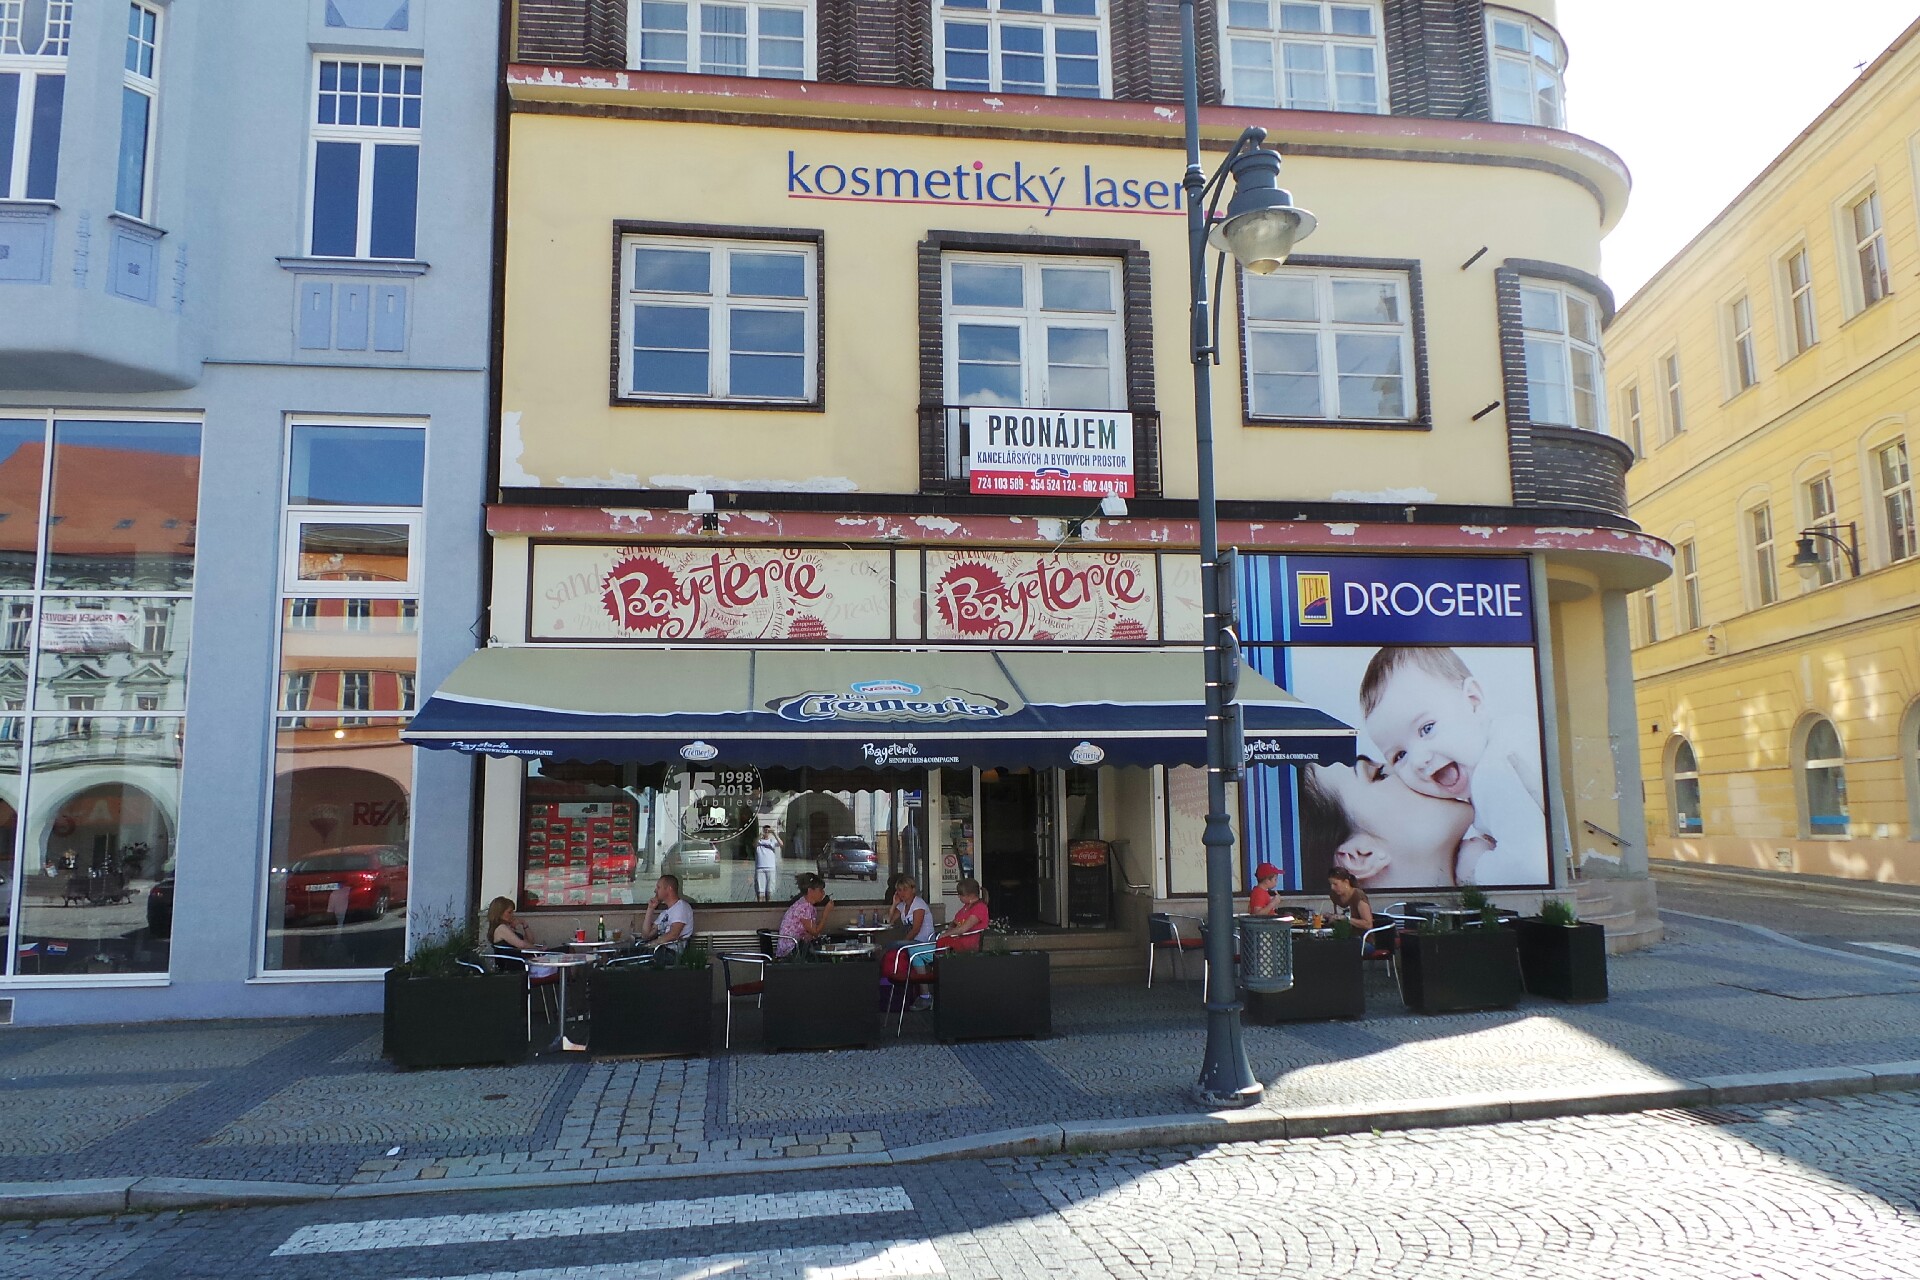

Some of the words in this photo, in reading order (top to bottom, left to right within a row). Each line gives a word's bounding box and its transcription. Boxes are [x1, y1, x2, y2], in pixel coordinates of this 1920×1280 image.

[788, 149, 1066, 217] kosmetický
[988, 412, 1117, 450] PRONÁJEM
[977, 451, 1041, 465] KANCELÁŘSKÝCH
[1043, 454, 1049, 465] A
[1051, 453, 1090, 467] BYTOVÝCH
[1092, 455, 1127, 468] PROSTOR
[977, 477, 991, 489] 724
[994, 477, 1008, 489] 103
[1031, 478, 1045, 491] 354
[1046, 479, 1060, 491] 524
[1063, 479, 1076, 491] 124
[1114, 480, 1128, 493] 761
[1301, 577, 1328, 607] TETA
[1343, 582, 1523, 617] DROGERIE
[777, 693, 1004, 723] Cremeria
[860, 742, 919, 766] Bageterie
[1244, 739, 1281, 762] ageterie
[673, 772, 717, 808] 15
[719, 771, 754, 784] 1998
[718, 784, 754, 796] 2013
